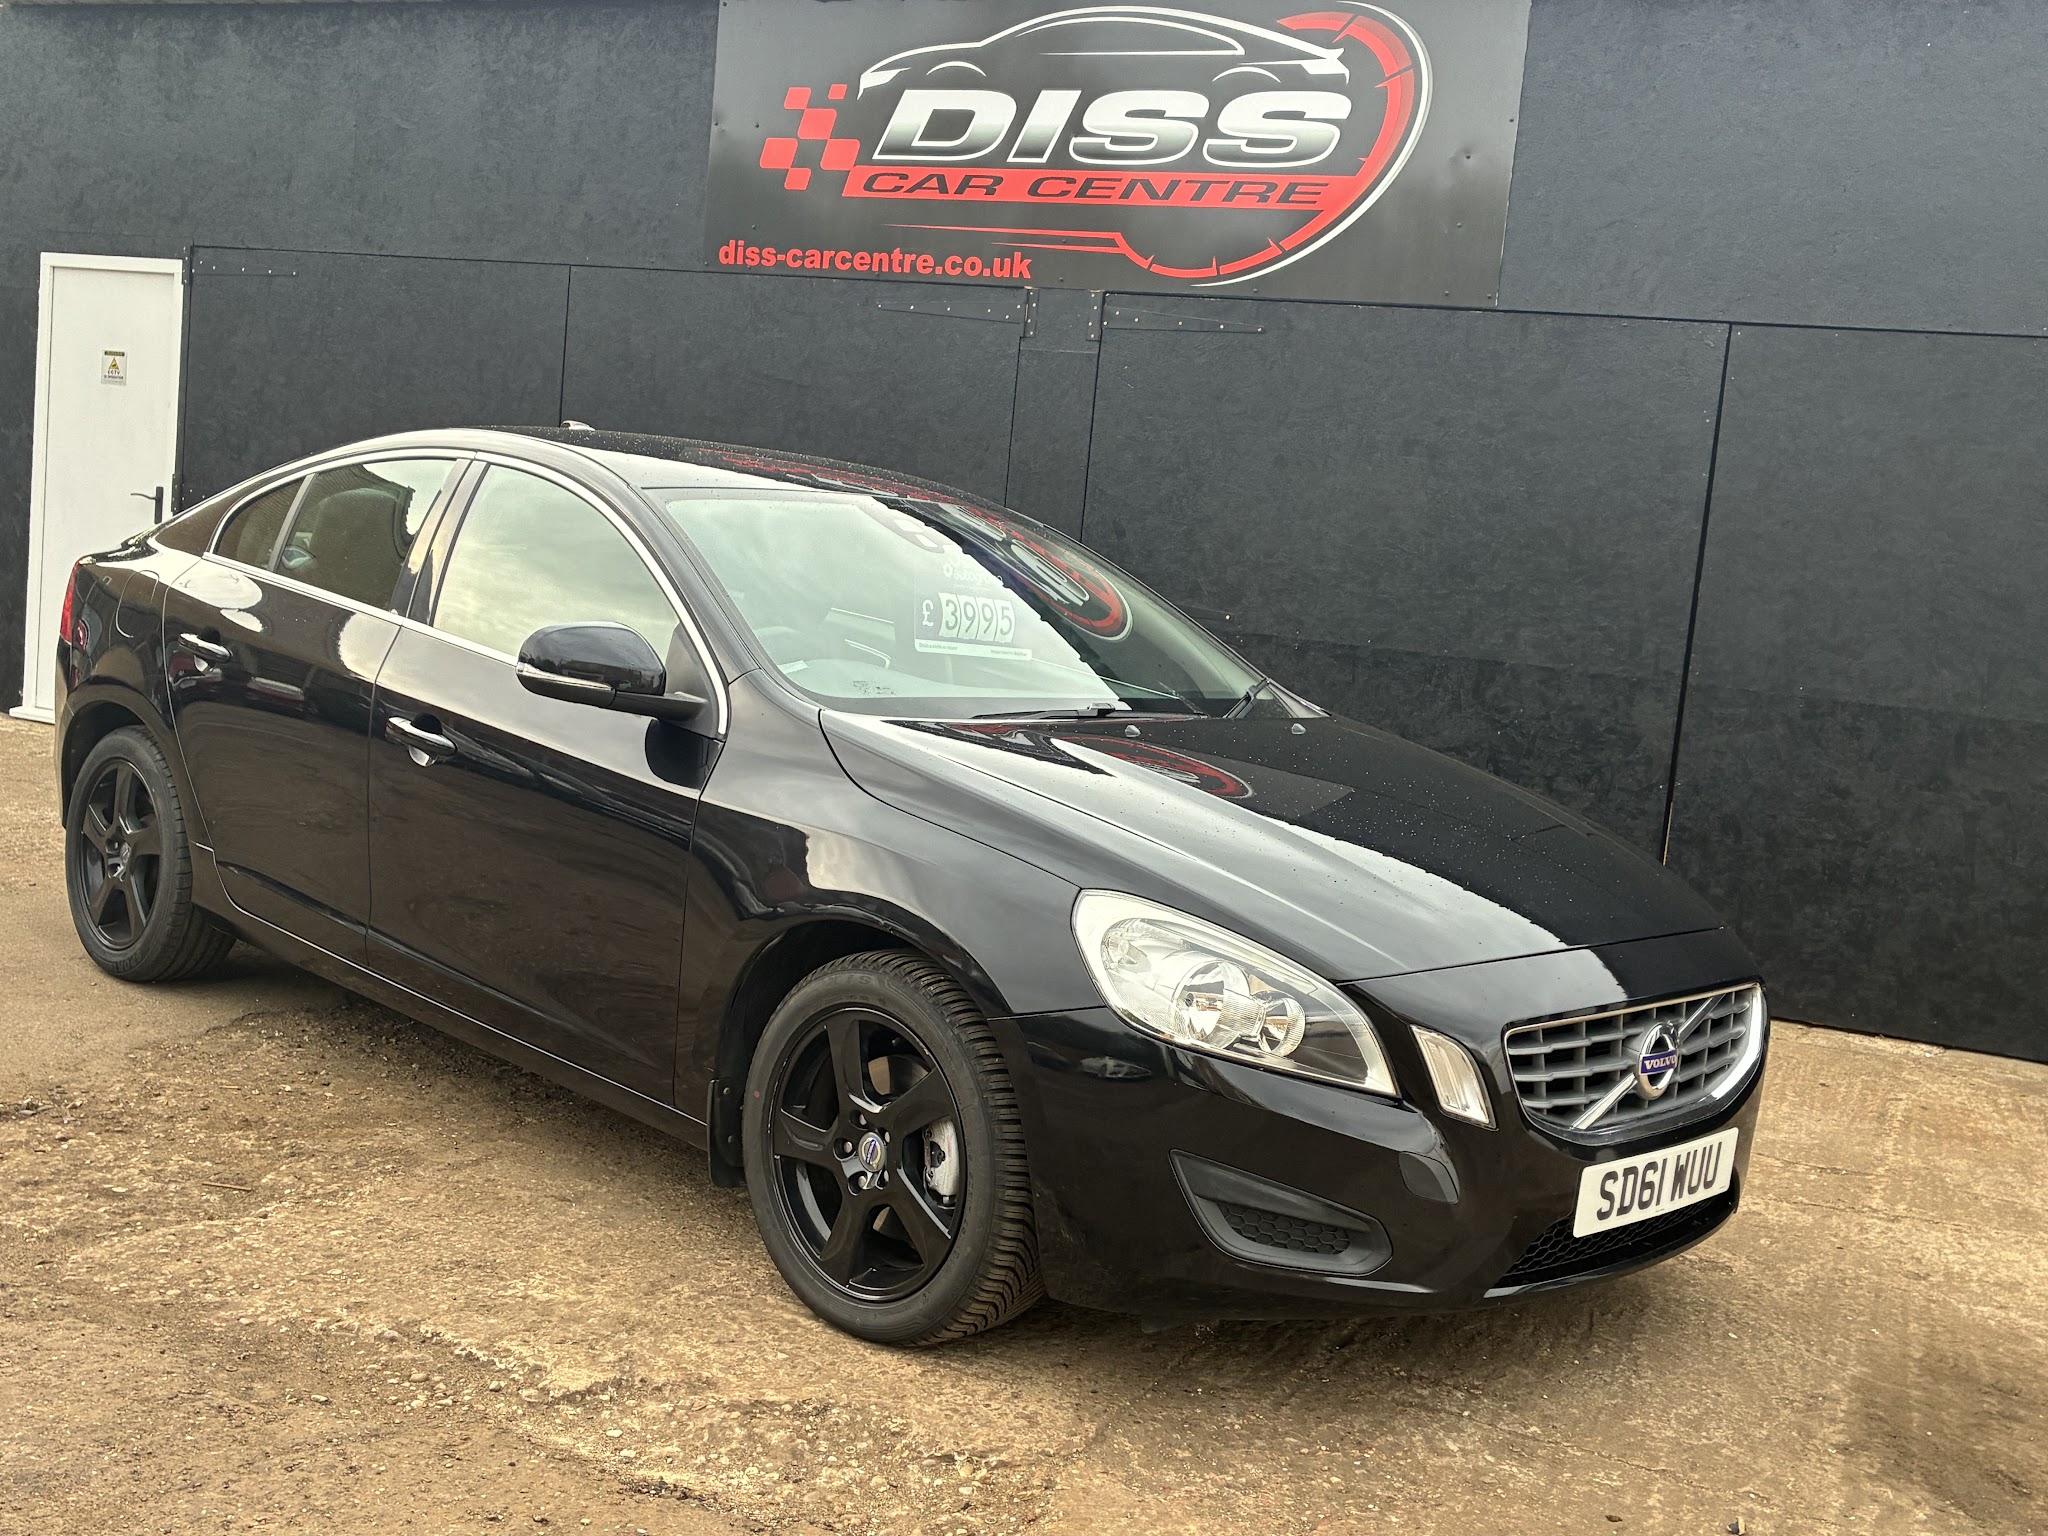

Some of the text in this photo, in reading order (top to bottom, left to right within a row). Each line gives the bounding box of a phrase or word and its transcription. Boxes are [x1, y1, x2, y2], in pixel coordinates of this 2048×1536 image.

[872, 89, 1353, 167] DISS
[862, 172, 1331, 205] CAR CENTRE
[718, 239, 1033, 279] diss-carcentre.co.uk
[1643, 1054, 1678, 1070] VOLVO
[1596, 1141, 1723, 1221] SD61 WUU
